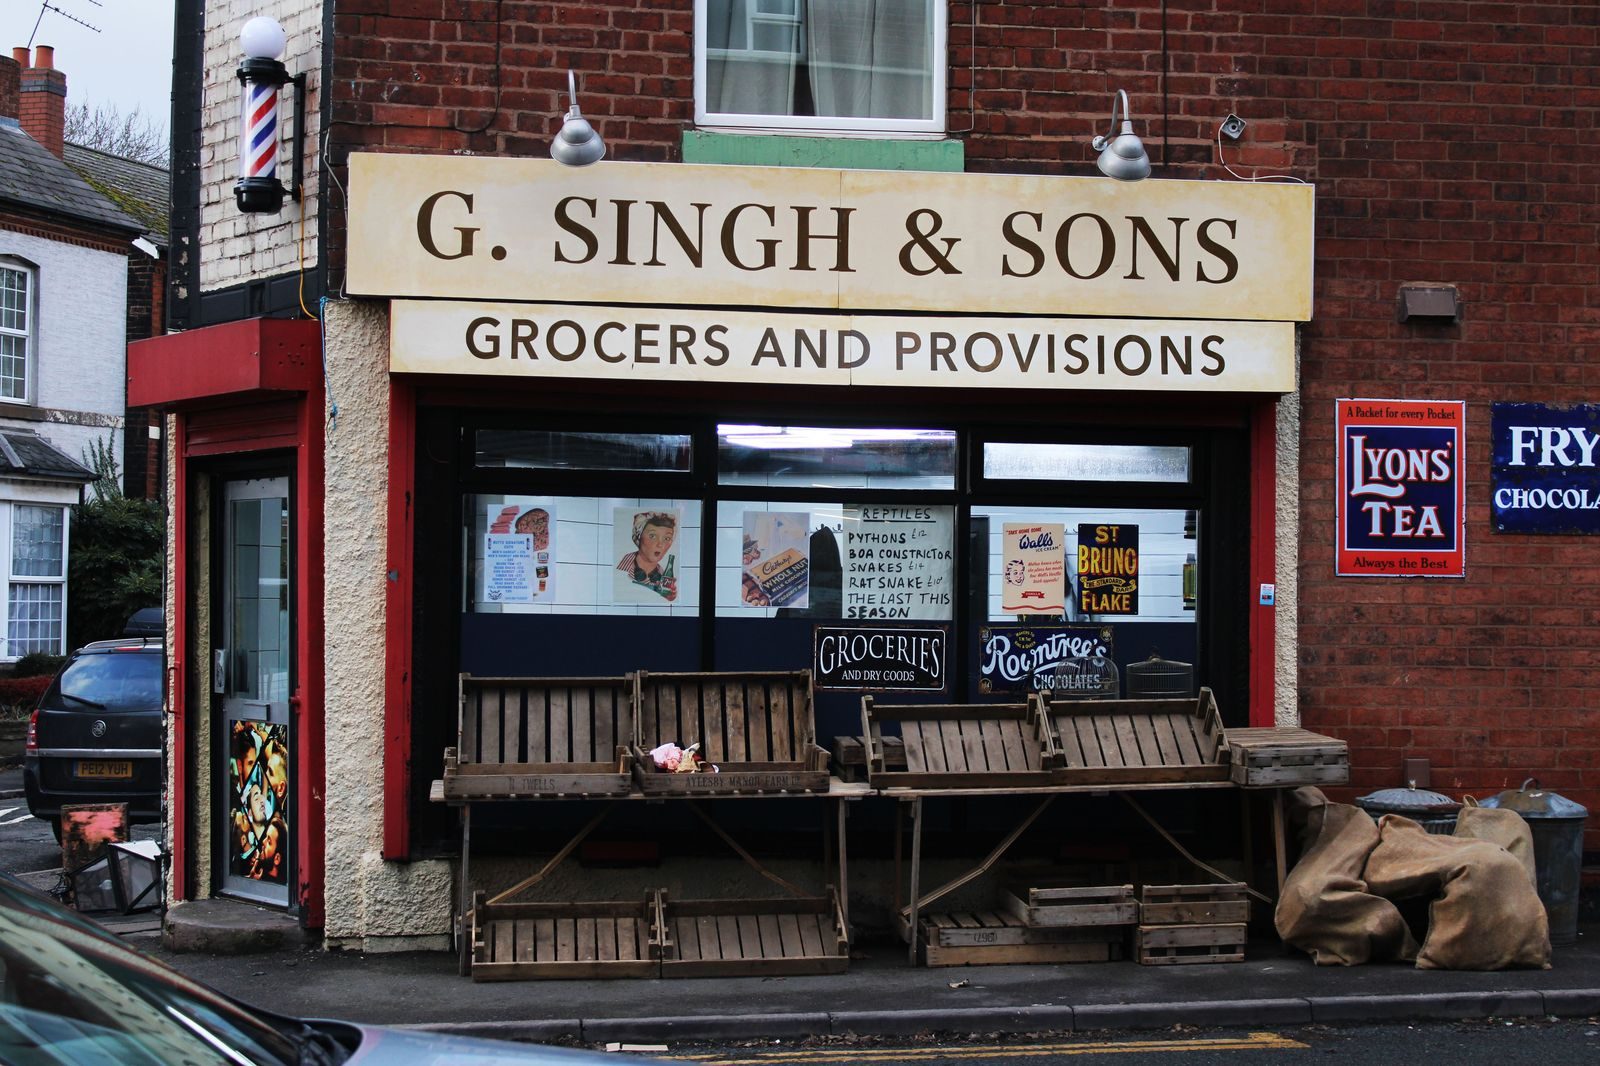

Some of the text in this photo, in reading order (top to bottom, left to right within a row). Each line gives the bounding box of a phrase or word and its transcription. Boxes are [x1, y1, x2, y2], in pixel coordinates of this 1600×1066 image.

[416, 190, 1240, 285] G. SINGH & SONS
[465, 316, 1226, 377] GROCERS AND PROVISIONS
[1346, 406, 1456, 420] A Packet for every Pocket
[862, 508, 931, 520] REPTILES
[1361, 501, 1446, 538] TEA
[848, 532, 906, 544] PYTHONS
[1019, 531, 1053, 550] Wall's
[849, 548, 952, 560] BOA CONSTRICTOR
[1078, 544, 1138, 577] BRUNO
[849, 562, 903, 573] SNAKES
[1353, 556, 1448, 571] Always the Best
[763, 568, 793, 589] WHOLE
[791, 559, 808, 572] NUT
[849, 576, 876, 589] RAT
[878, 576, 923, 589] SNAKE
[848, 592, 951, 606] THE LAST THIS
[1081, 590, 1131, 612] FLAKE
[847, 606, 911, 619] SEASON
[819, 634, 940, 678] GROCERIES
[841, 669, 915, 681] AND DRY GOODS
[1033, 673, 1102, 690] CHOCOLATES
[765, 775, 788, 787] FARM
